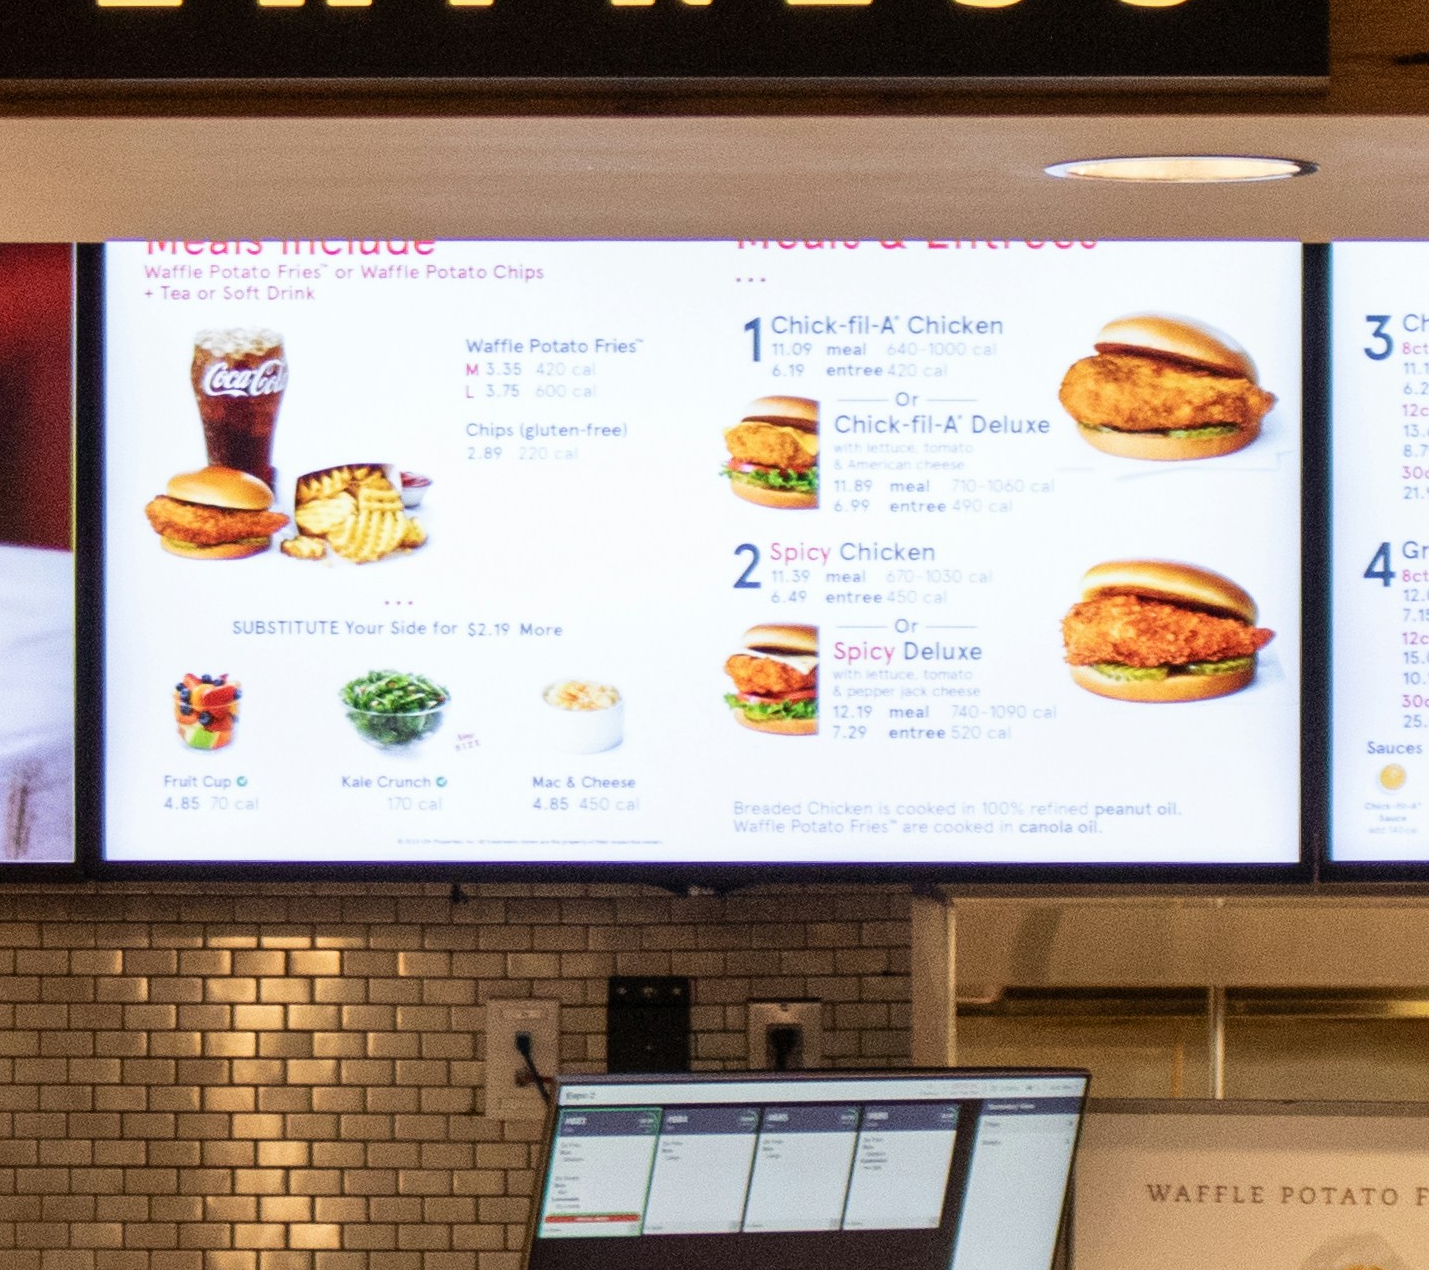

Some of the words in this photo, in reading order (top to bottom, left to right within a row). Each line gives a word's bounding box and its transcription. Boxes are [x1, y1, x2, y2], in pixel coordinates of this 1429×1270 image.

[144, 265, 203, 279] Waffle
[210, 265, 270, 279] Potato
[335, 268, 353, 279] or
[361, 265, 419, 279] Waffle
[427, 265, 486, 279] Potato
[494, 265, 543, 282] Chips
[161, 286, 190, 300] Tea
[197, 289, 216, 300] or
[224, 286, 260, 300] Soft
[268, 286, 315, 300] Drink
[744, 317, 761, 362] 1
[908, 316, 1003, 335] Chicken
[1364, 314, 1394, 361] 3
[466, 339, 524, 354] Waffle
[530, 339, 588, 354] Potato
[772, 343, 812, 356] 11.09
[826, 343, 866, 356] meal
[895, 392, 919, 407] Or
[466, 423, 513, 439] Chips
[520, 422, 627, 439] (gluten-free)
[973, 415, 1050, 434] Deluxe
[732, 543, 761, 589] 2
[770, 543, 831, 566] Spicy
[839, 543, 935, 562] Chicken
[1363, 542, 1395, 587] 4
[232, 620, 339, 636] SUBSTITUTE
[345, 620, 385, 636] Your
[390, 620, 427, 636] Side
[432, 620, 457, 636] for
[468, 622, 510, 637] $2.19
[520, 623, 563, 637] More
[895, 618, 919, 634] Or
[833, 641, 895, 666] Spicy
[904, 642, 983, 661] Deluxe
[1366, 742, 1423, 755] Sauces
[163, 776, 199, 788] Fruit
[203, 776, 232, 791] Cup
[342, 776, 373, 788] Kale
[377, 776, 432, 788] Crunch
[533, 776, 561, 788] Mac
[566, 776, 575, 788] &
[581, 776, 636, 788] Cheese
[1146, 1184, 1264, 1204] WAFFLE
[1281, 1186, 1398, 1206] POTATO
